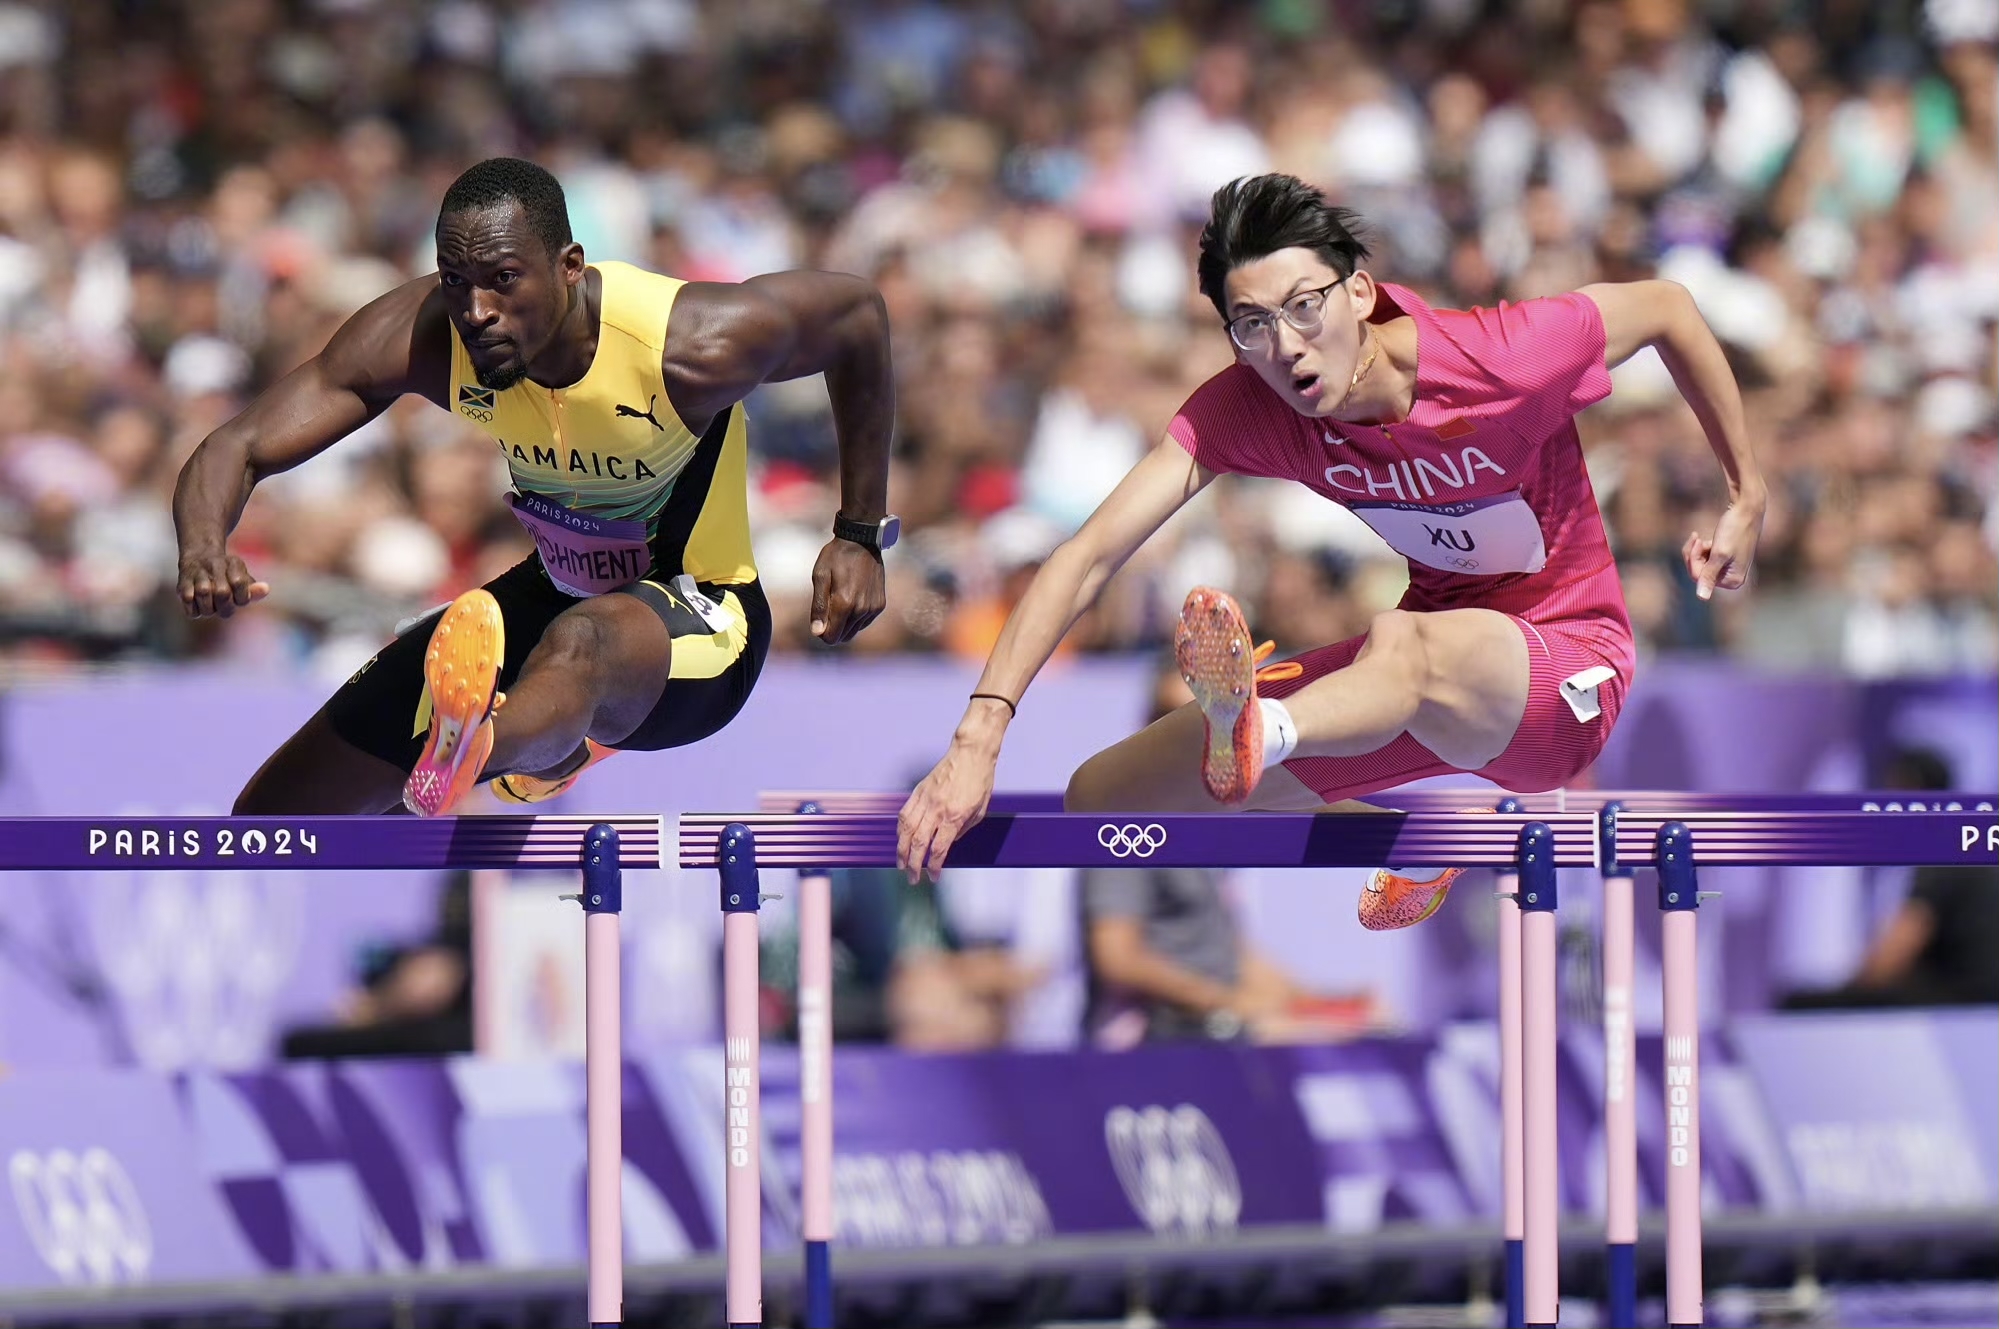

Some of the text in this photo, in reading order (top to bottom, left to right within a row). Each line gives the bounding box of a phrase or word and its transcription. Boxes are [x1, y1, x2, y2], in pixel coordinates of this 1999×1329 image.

[1325, 446, 1506, 500] CHINA
[564, 513, 601, 532] 2024
[1435, 502, 1475, 514] 2024
[1421, 523, 1475, 552] XU
[216, 828, 318, 856] 2024
[727, 1067, 751, 1168] MONDO
[1667, 1066, 1692, 1167] MONDO
